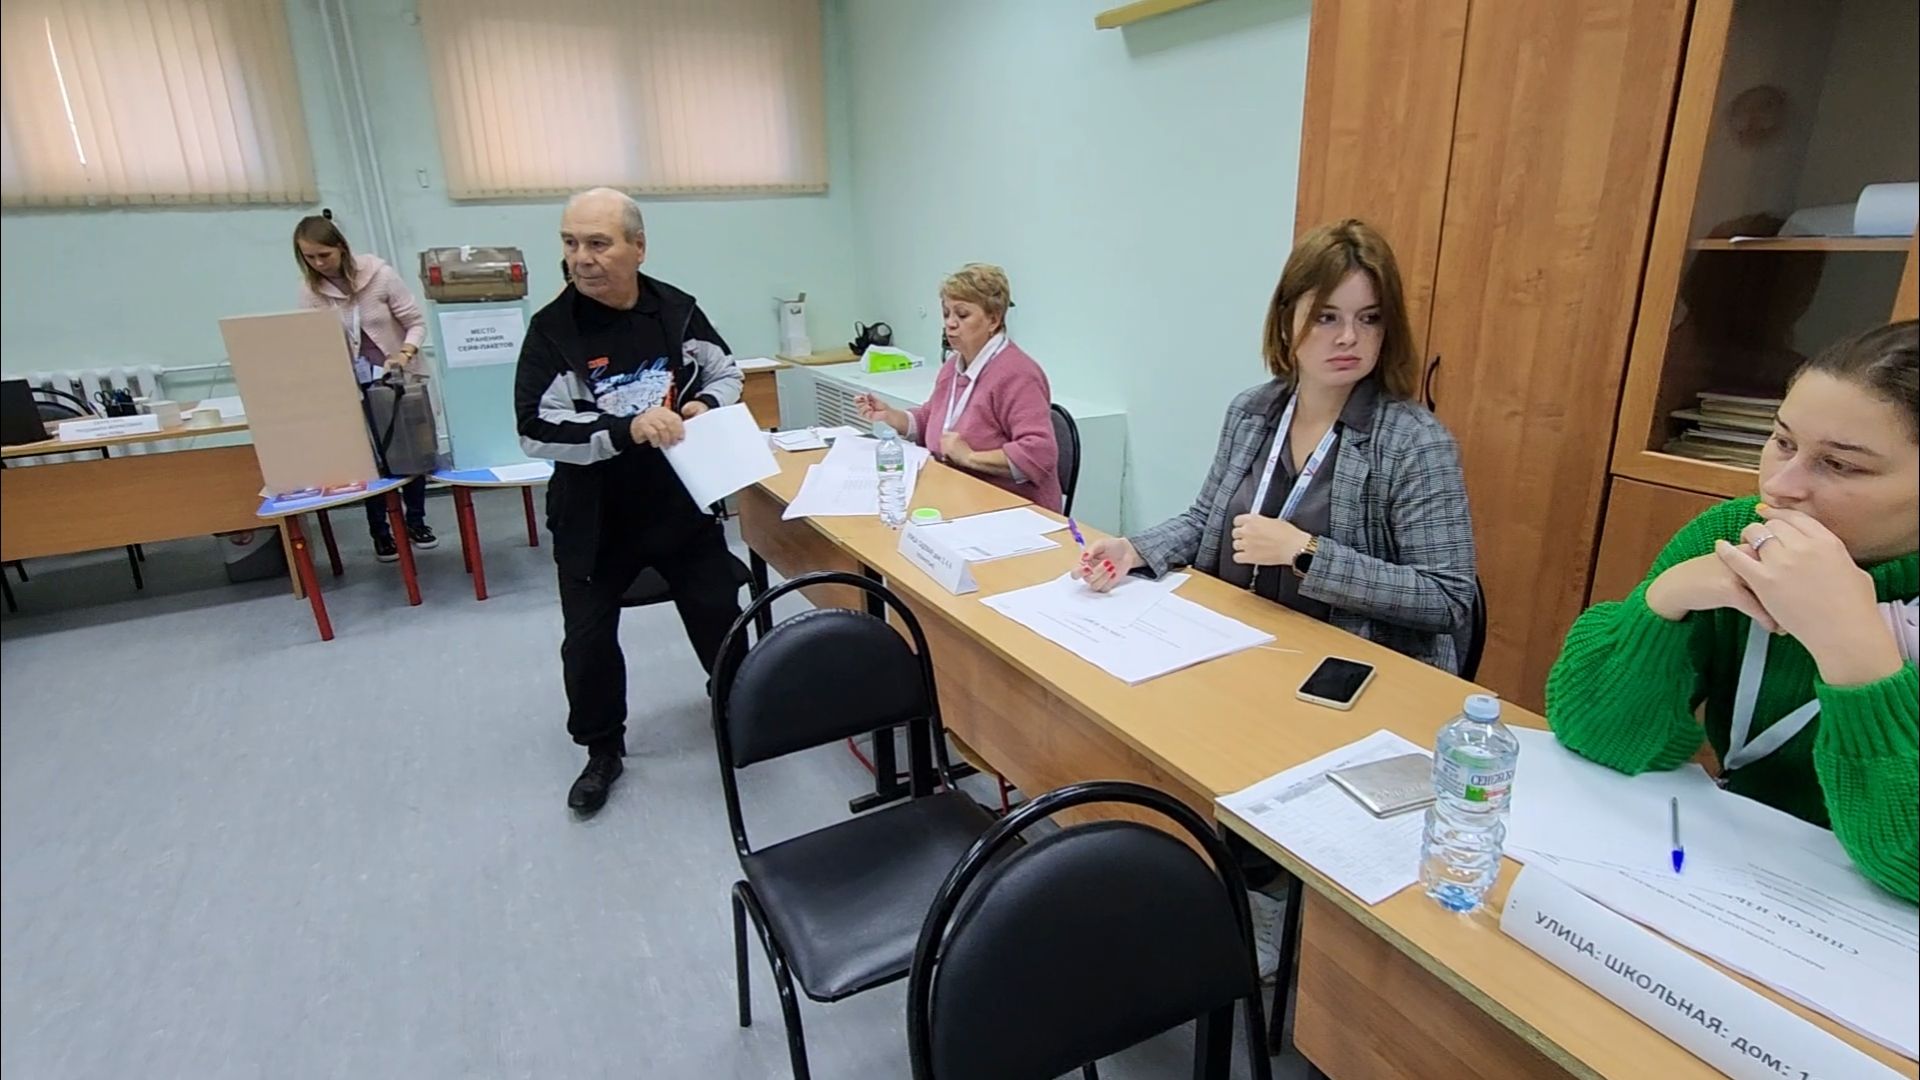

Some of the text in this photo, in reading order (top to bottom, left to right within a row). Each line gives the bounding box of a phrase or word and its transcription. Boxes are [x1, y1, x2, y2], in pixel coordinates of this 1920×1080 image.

[470, 327, 496, 335] МЕСТО
[465, 335, 504, 343] ХРАНЕНИЯ
[457, 342, 514, 352] СЕЙФ-ПАКЕТОВ
[1773, 912, 1859, 955] СПИСОК
[1534, 910, 1602, 961] УЛИЦА:
[1604, 953, 1729, 1039] ШКОЛЬНАЯ:
